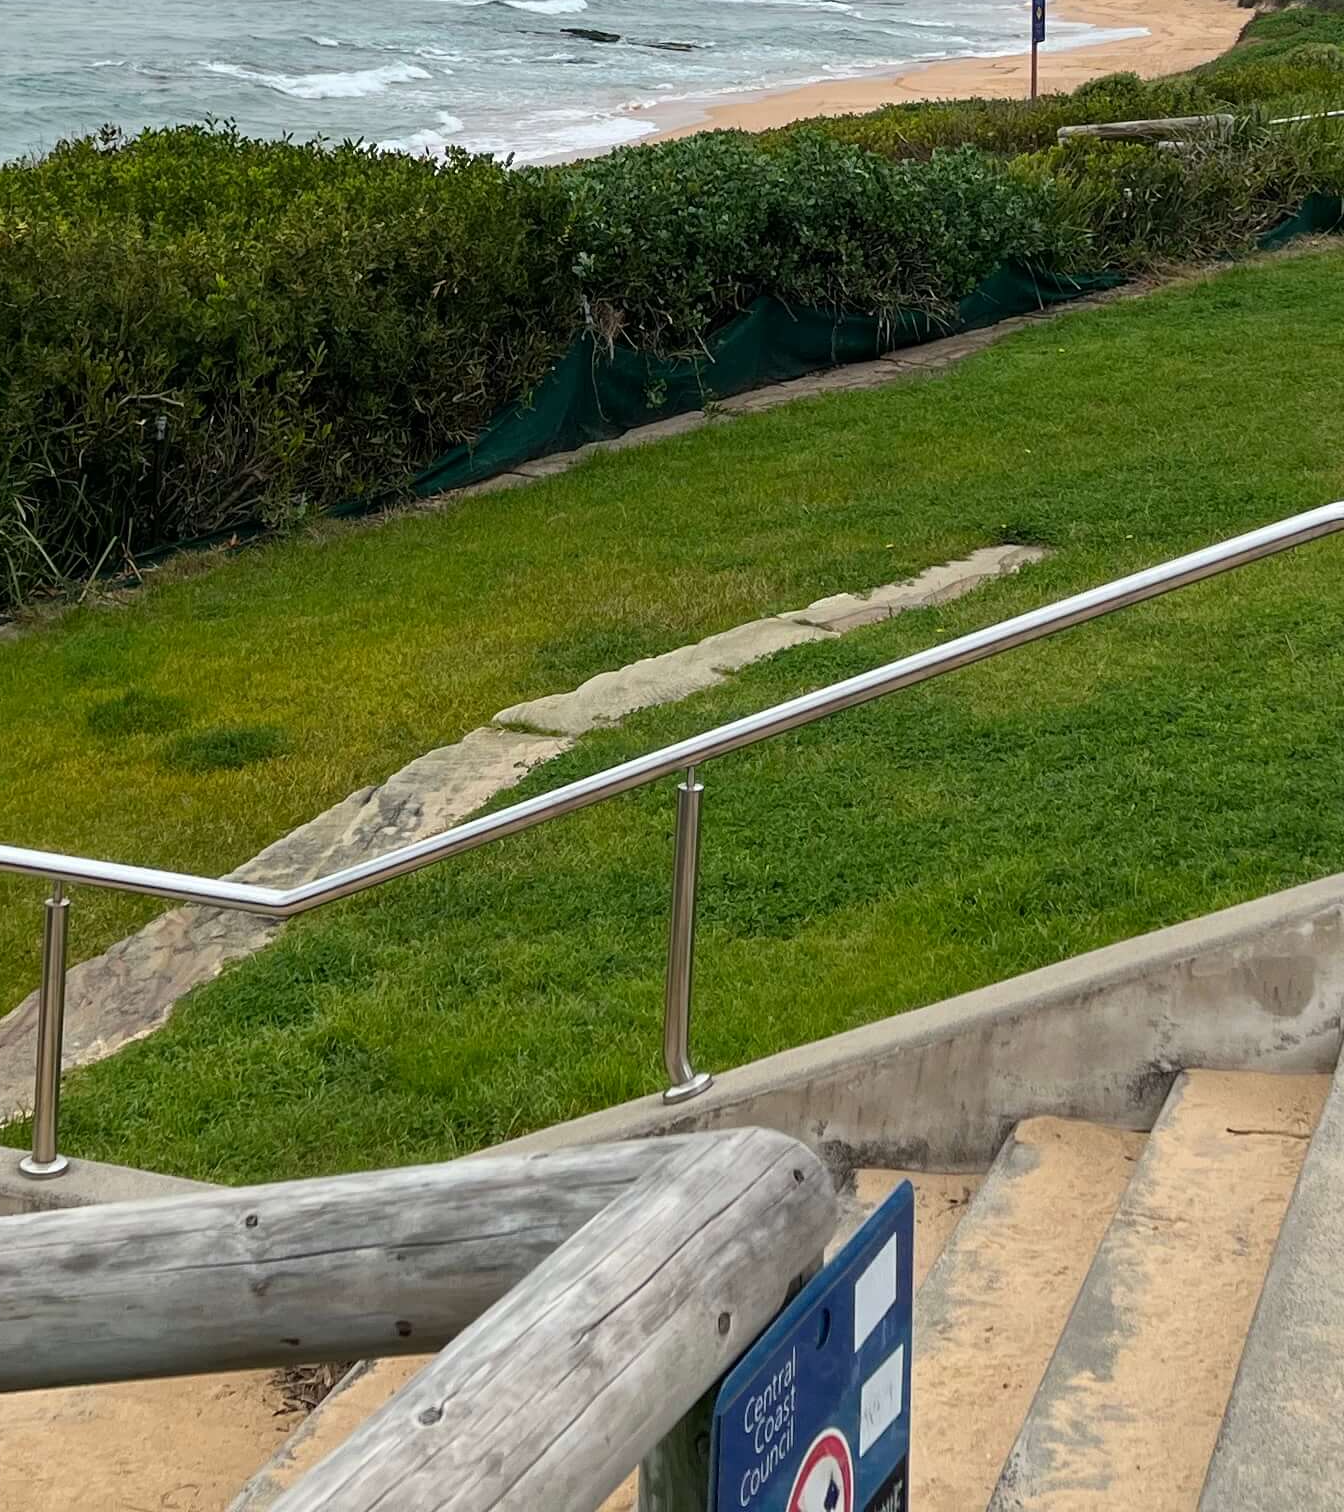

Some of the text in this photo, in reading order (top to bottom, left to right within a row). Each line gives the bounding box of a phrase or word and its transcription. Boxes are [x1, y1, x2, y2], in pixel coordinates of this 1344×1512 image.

[744, 1345, 796, 1433] Central
[755, 1384, 796, 1454] Coast
[740, 1415, 794, 1507] Council
